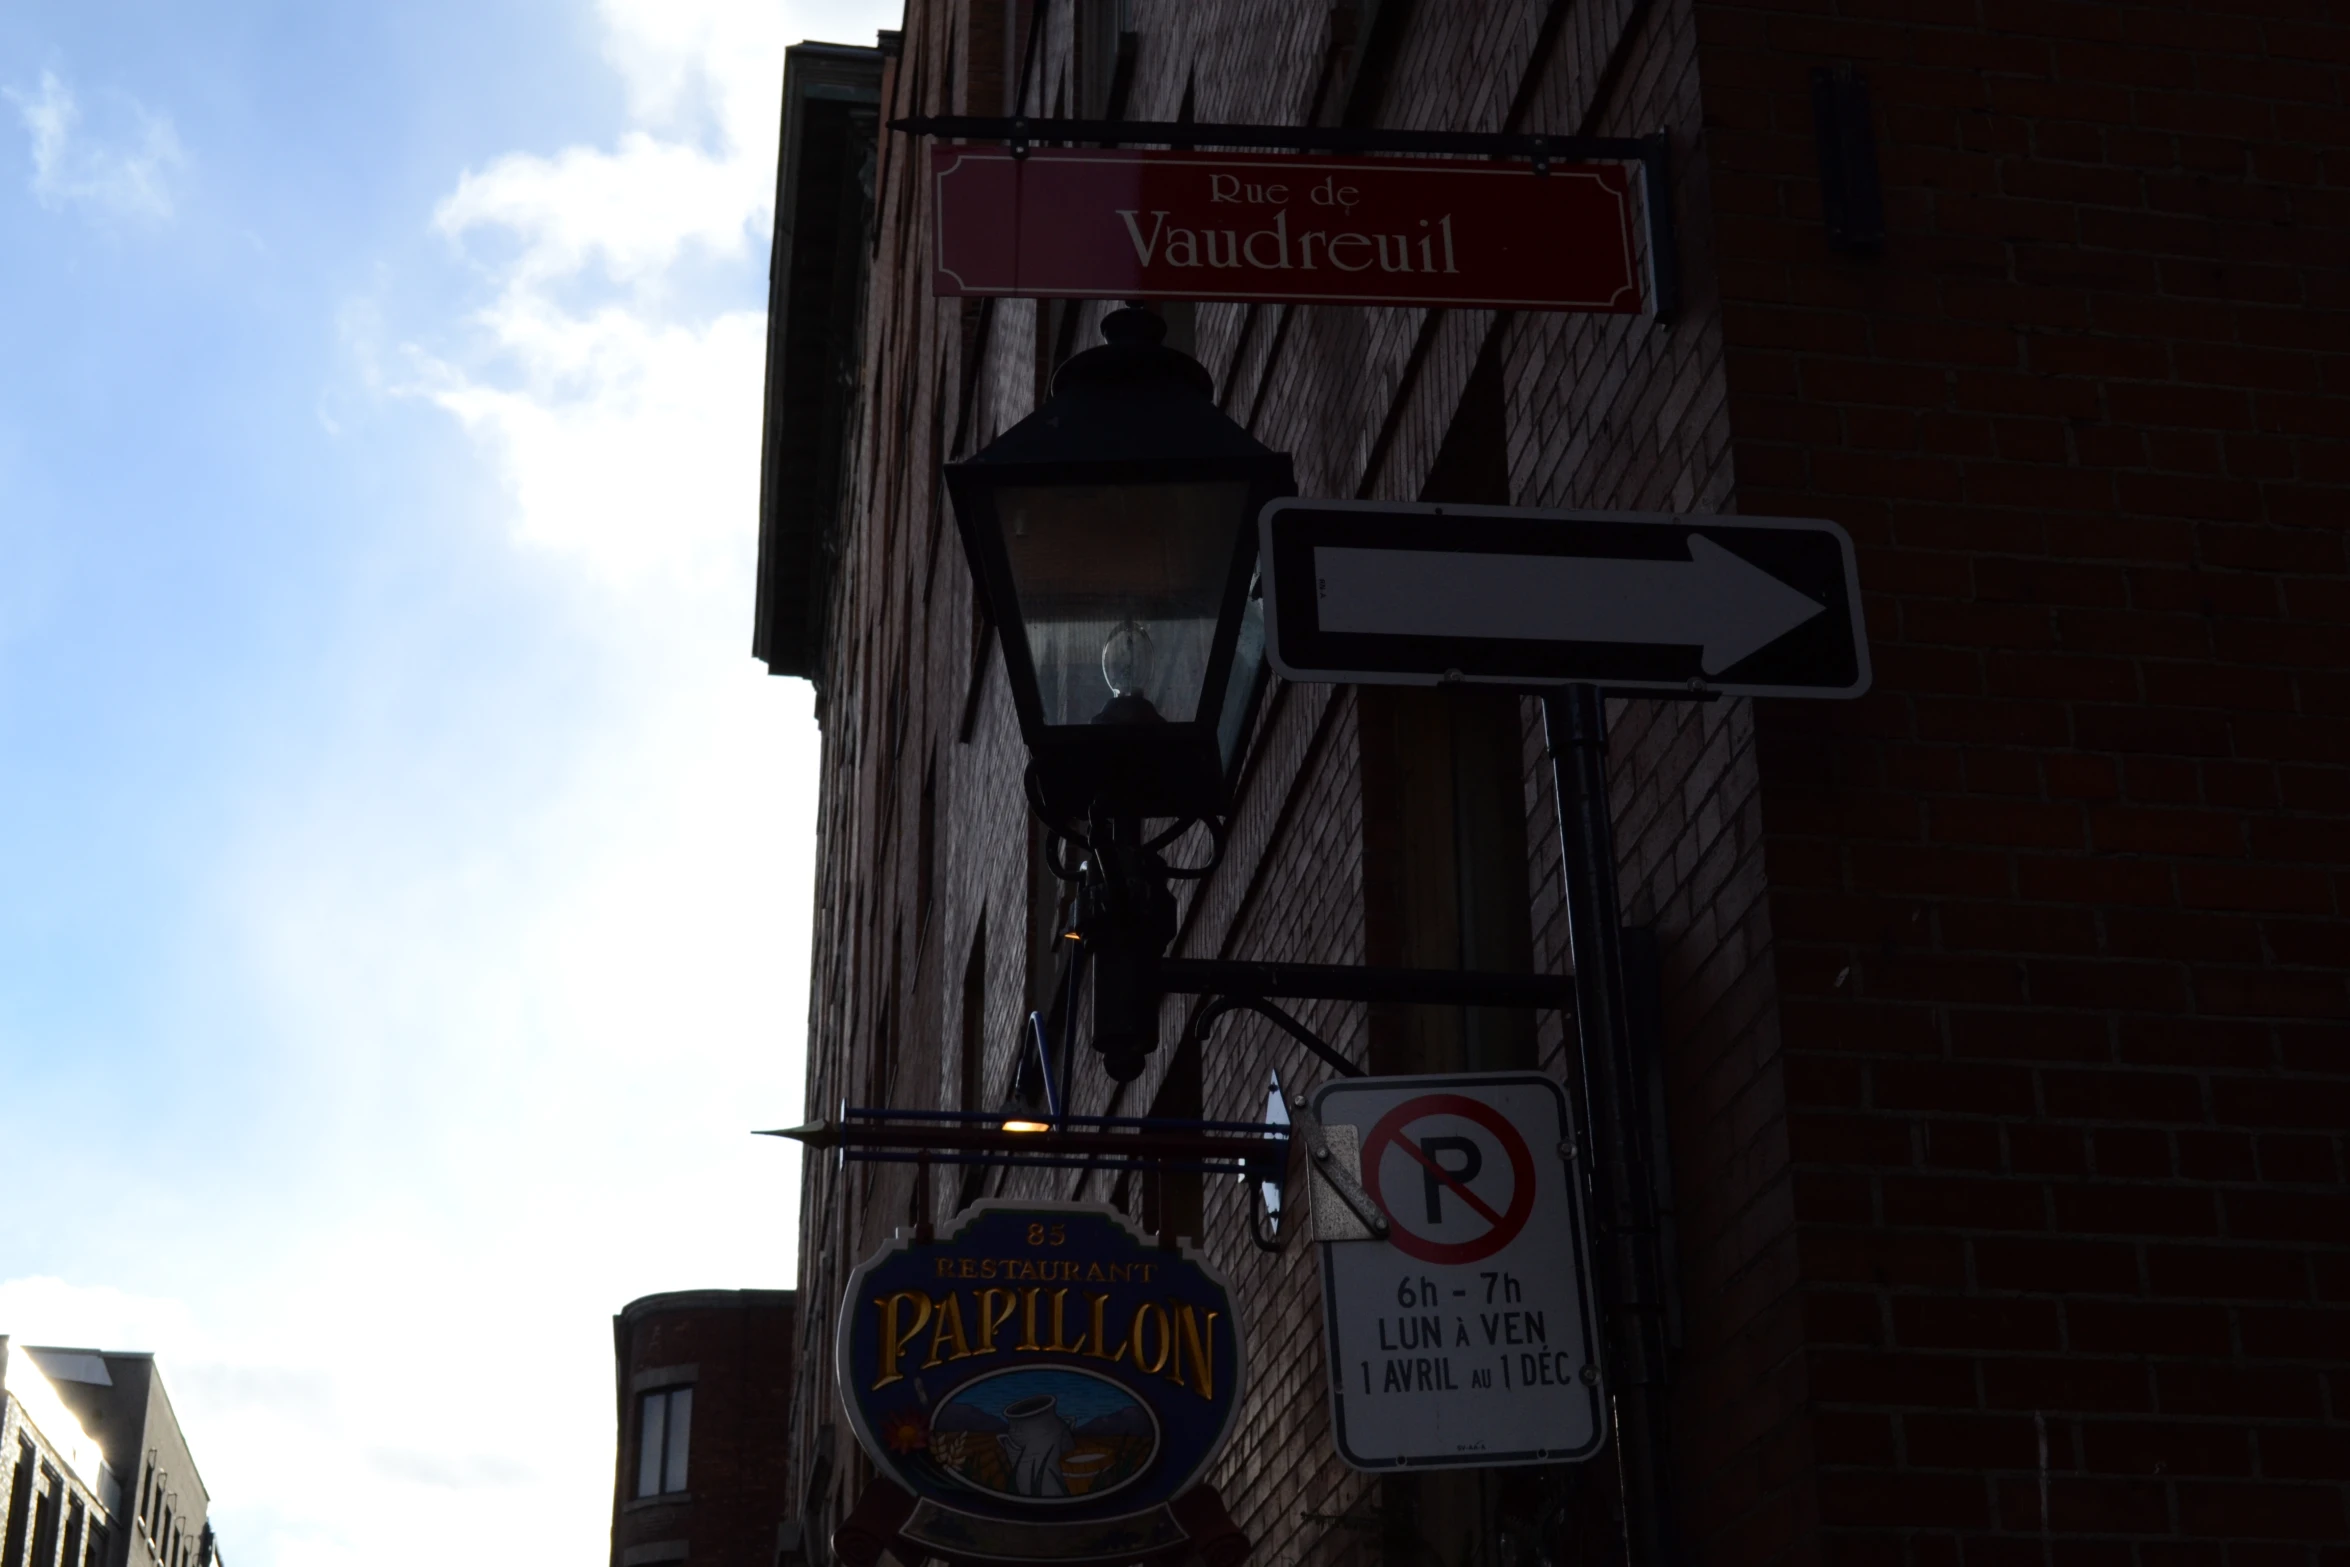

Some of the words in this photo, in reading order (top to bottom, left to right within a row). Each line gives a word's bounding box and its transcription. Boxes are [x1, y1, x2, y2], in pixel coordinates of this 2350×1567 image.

[1209, 173, 1290, 205] Rue
[1310, 175, 1360, 206] de
[1115, 208, 1460, 275] Vaudreuil
[1026, 1223, 1066, 1246] 85
[934, 1257, 1158, 1283] RESTAURANT
[1398, 1276, 1438, 1308] 6h
[1480, 1272, 1522, 1304] 7h
[872, 1287, 1219, 1401] PAPILLON
[1378, 1316, 1441, 1350] LUN
[1456, 1318, 1470, 1347] À
[1480, 1311, 1546, 1346] VEN
[1361, 1361, 1371, 1394] 1
[1384, 1357, 1458, 1392] AVRIL
[1472, 1369, 1491, 1389] AU
[1500, 1355, 1511, 1392] 1
[1521, 1345, 1571, 1386] DÉC
